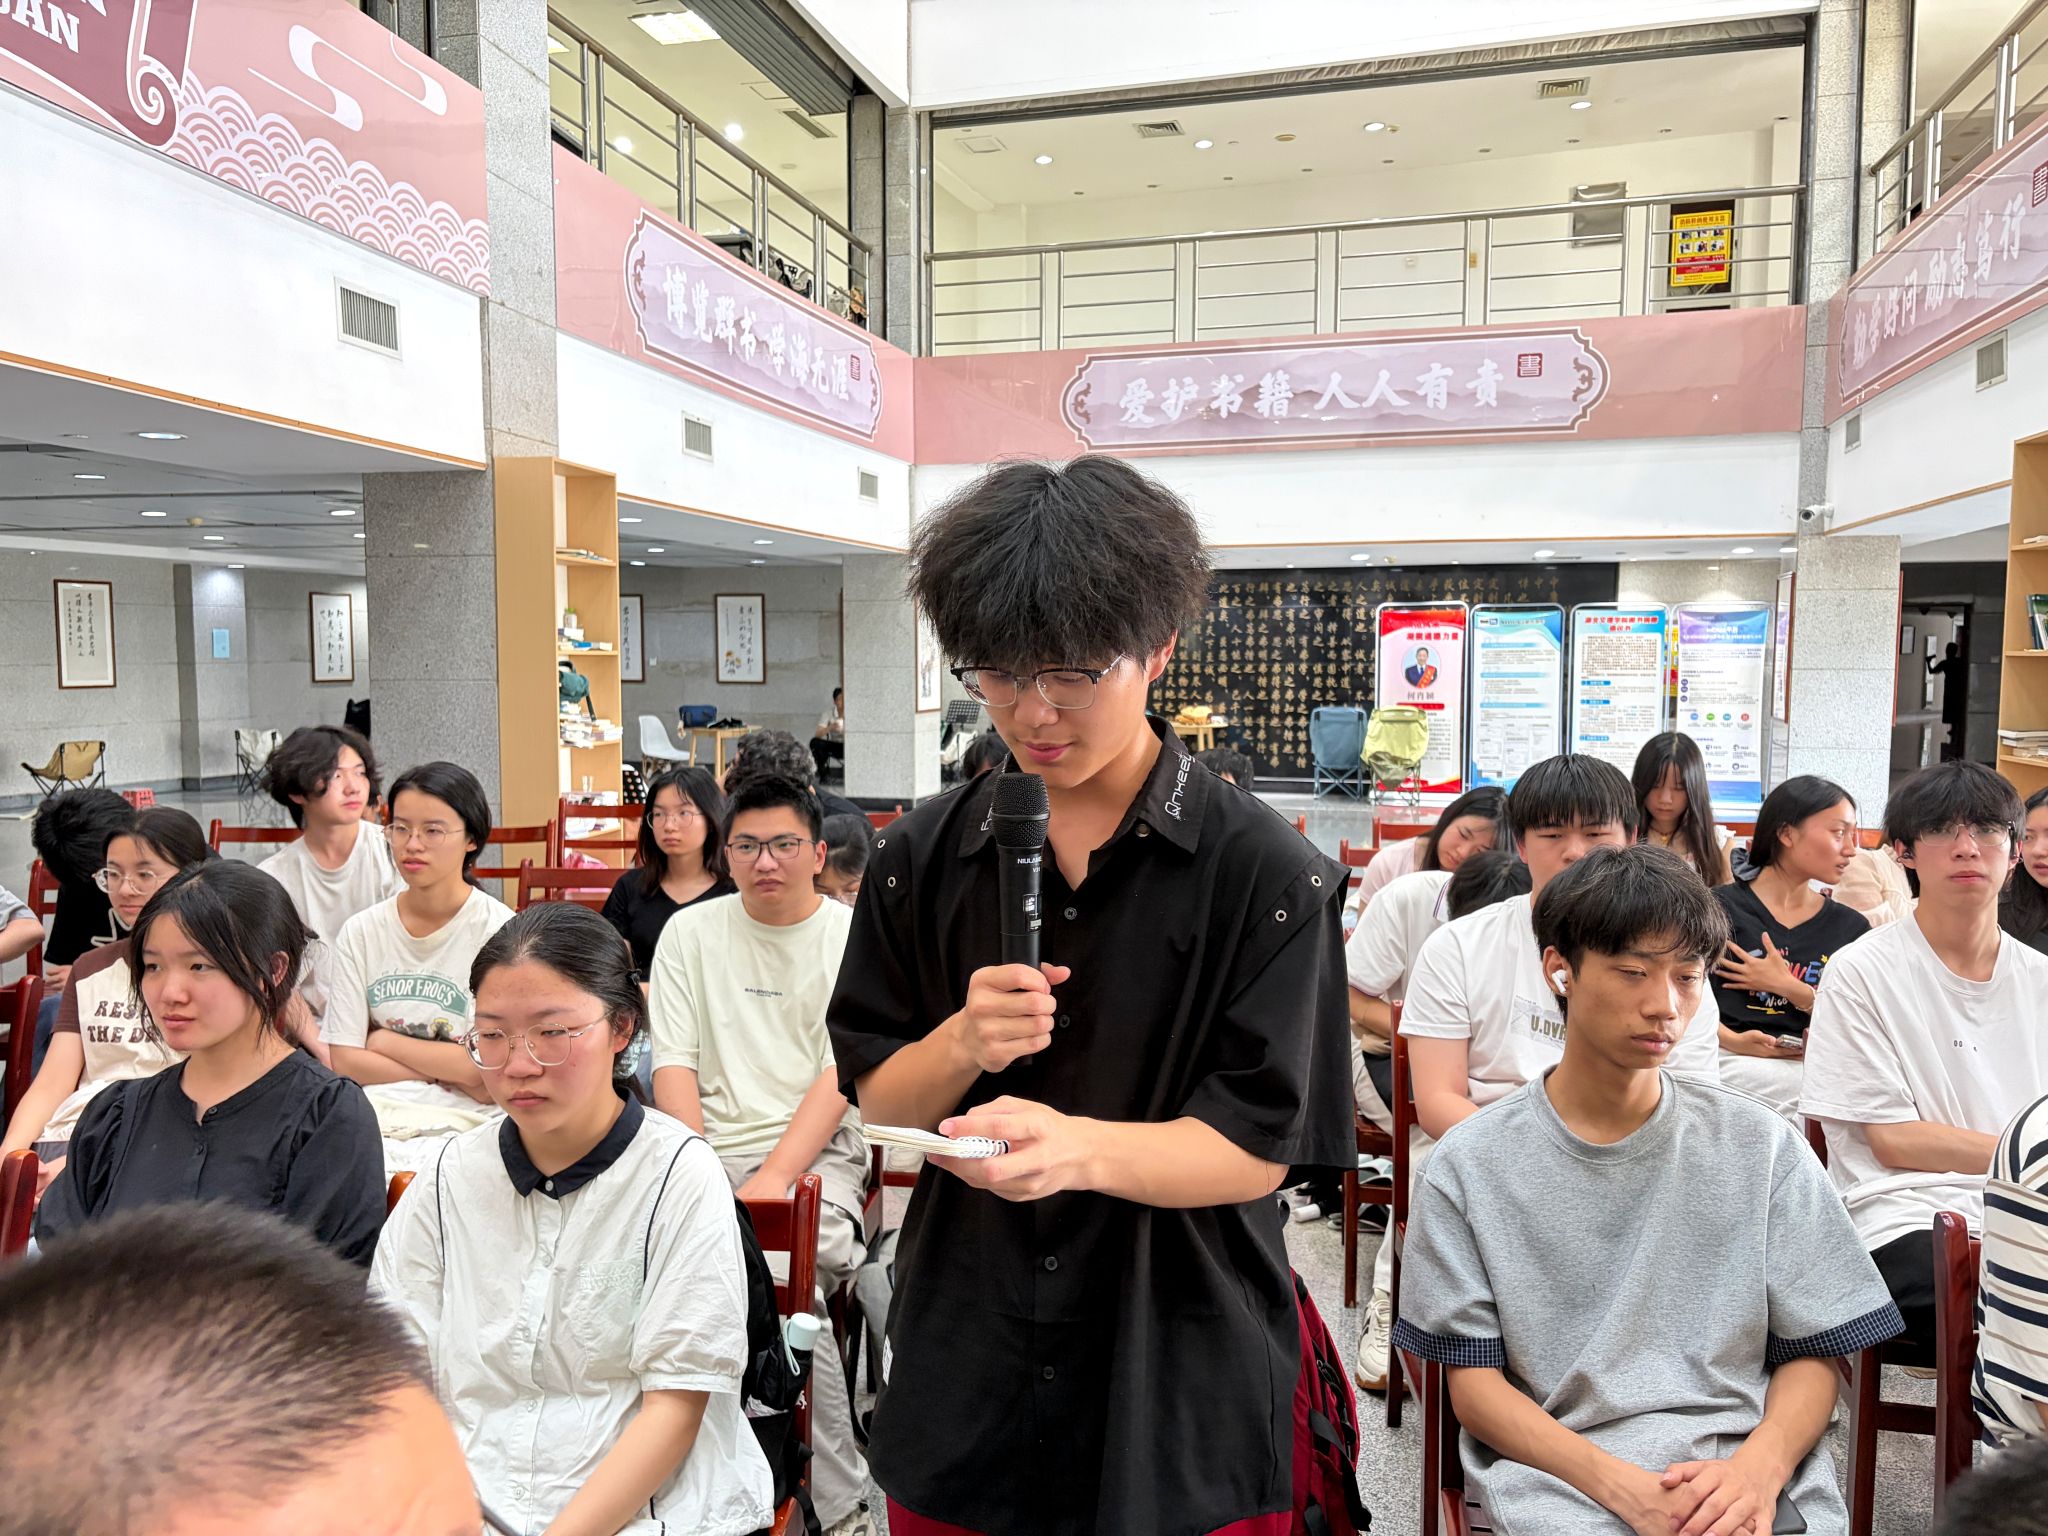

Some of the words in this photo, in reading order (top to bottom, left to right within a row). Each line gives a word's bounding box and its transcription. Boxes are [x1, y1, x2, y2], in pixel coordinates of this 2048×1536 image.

[1118, 369, 1294, 424] 爱护书籍
[1313, 358, 1504, 411] 人人有责
[374, 979, 415, 1001] SENOR
[416, 980, 456, 1006] FROG'S
[95, 1001, 139, 1019] RES
[87, 1026, 125, 1043] THE
